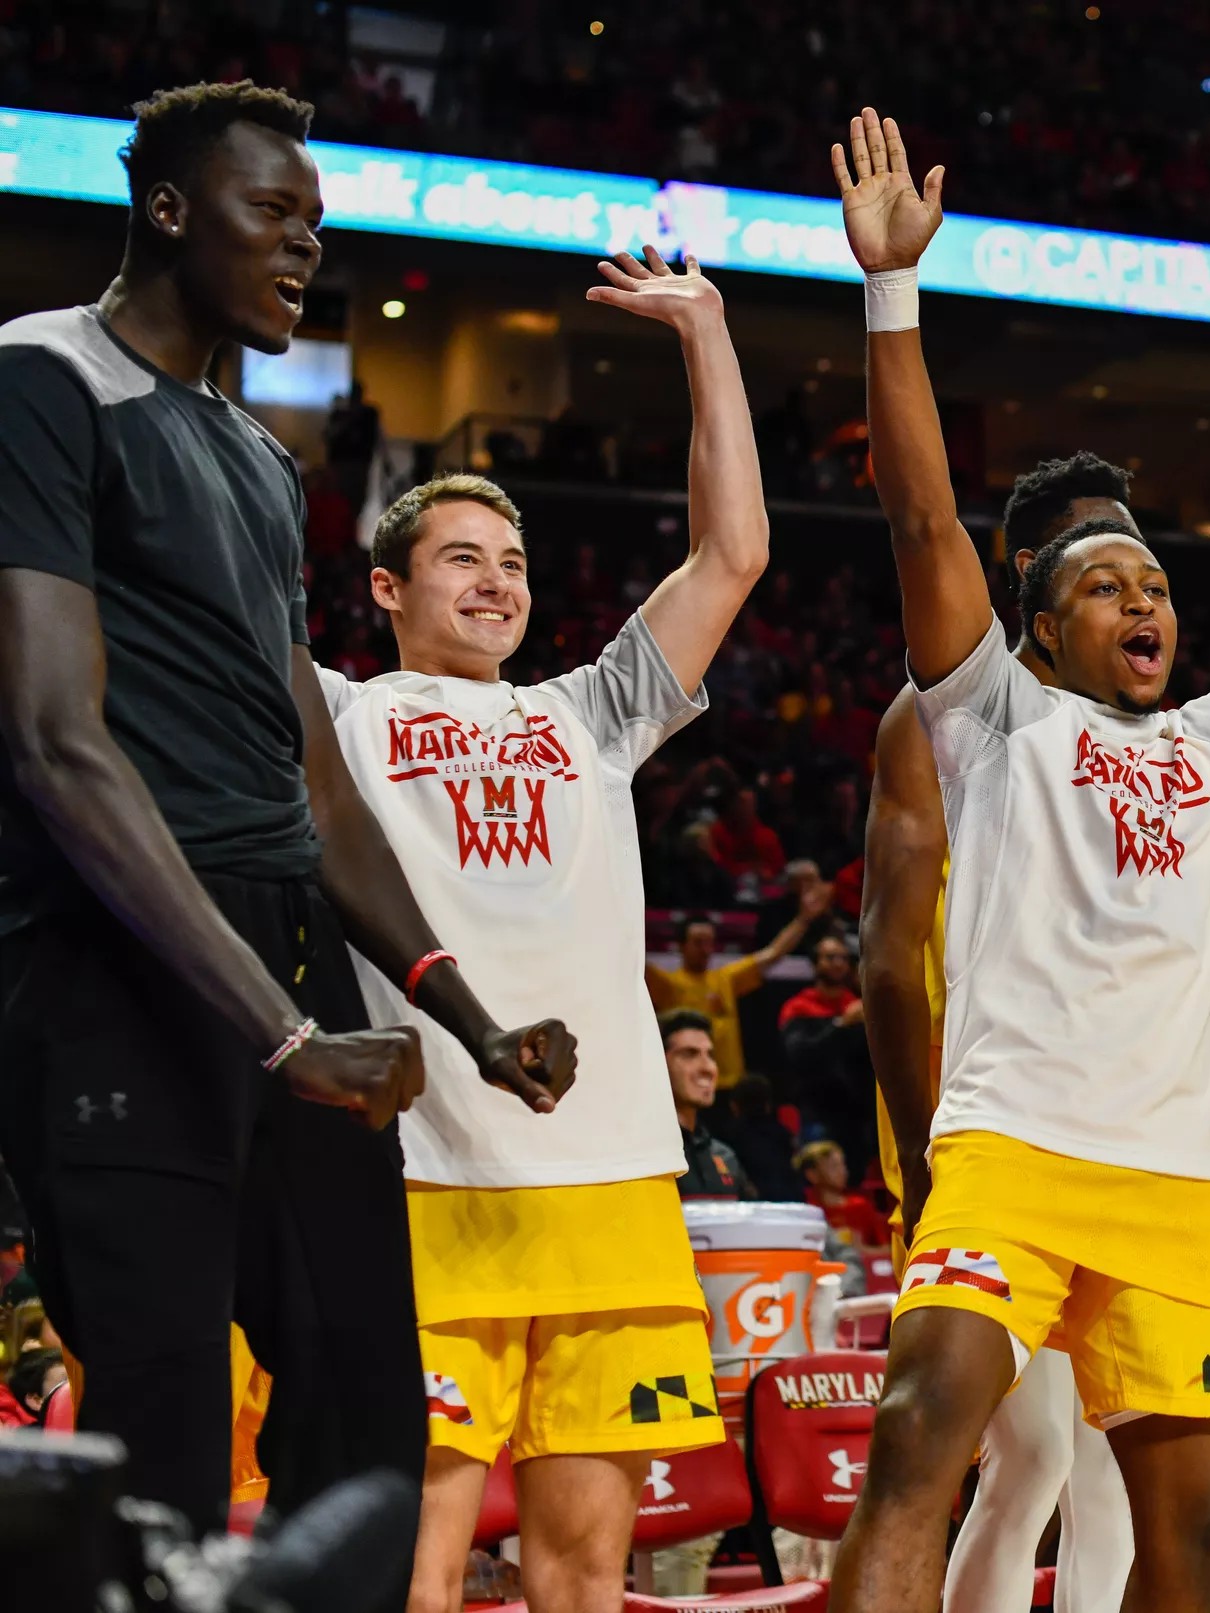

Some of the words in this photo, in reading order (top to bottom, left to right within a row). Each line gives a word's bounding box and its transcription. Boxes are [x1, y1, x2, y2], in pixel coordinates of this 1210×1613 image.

[424, 172, 599, 240] about
[445, 761, 503, 774] COLLEGE
[737, 1281, 784, 1338] G
